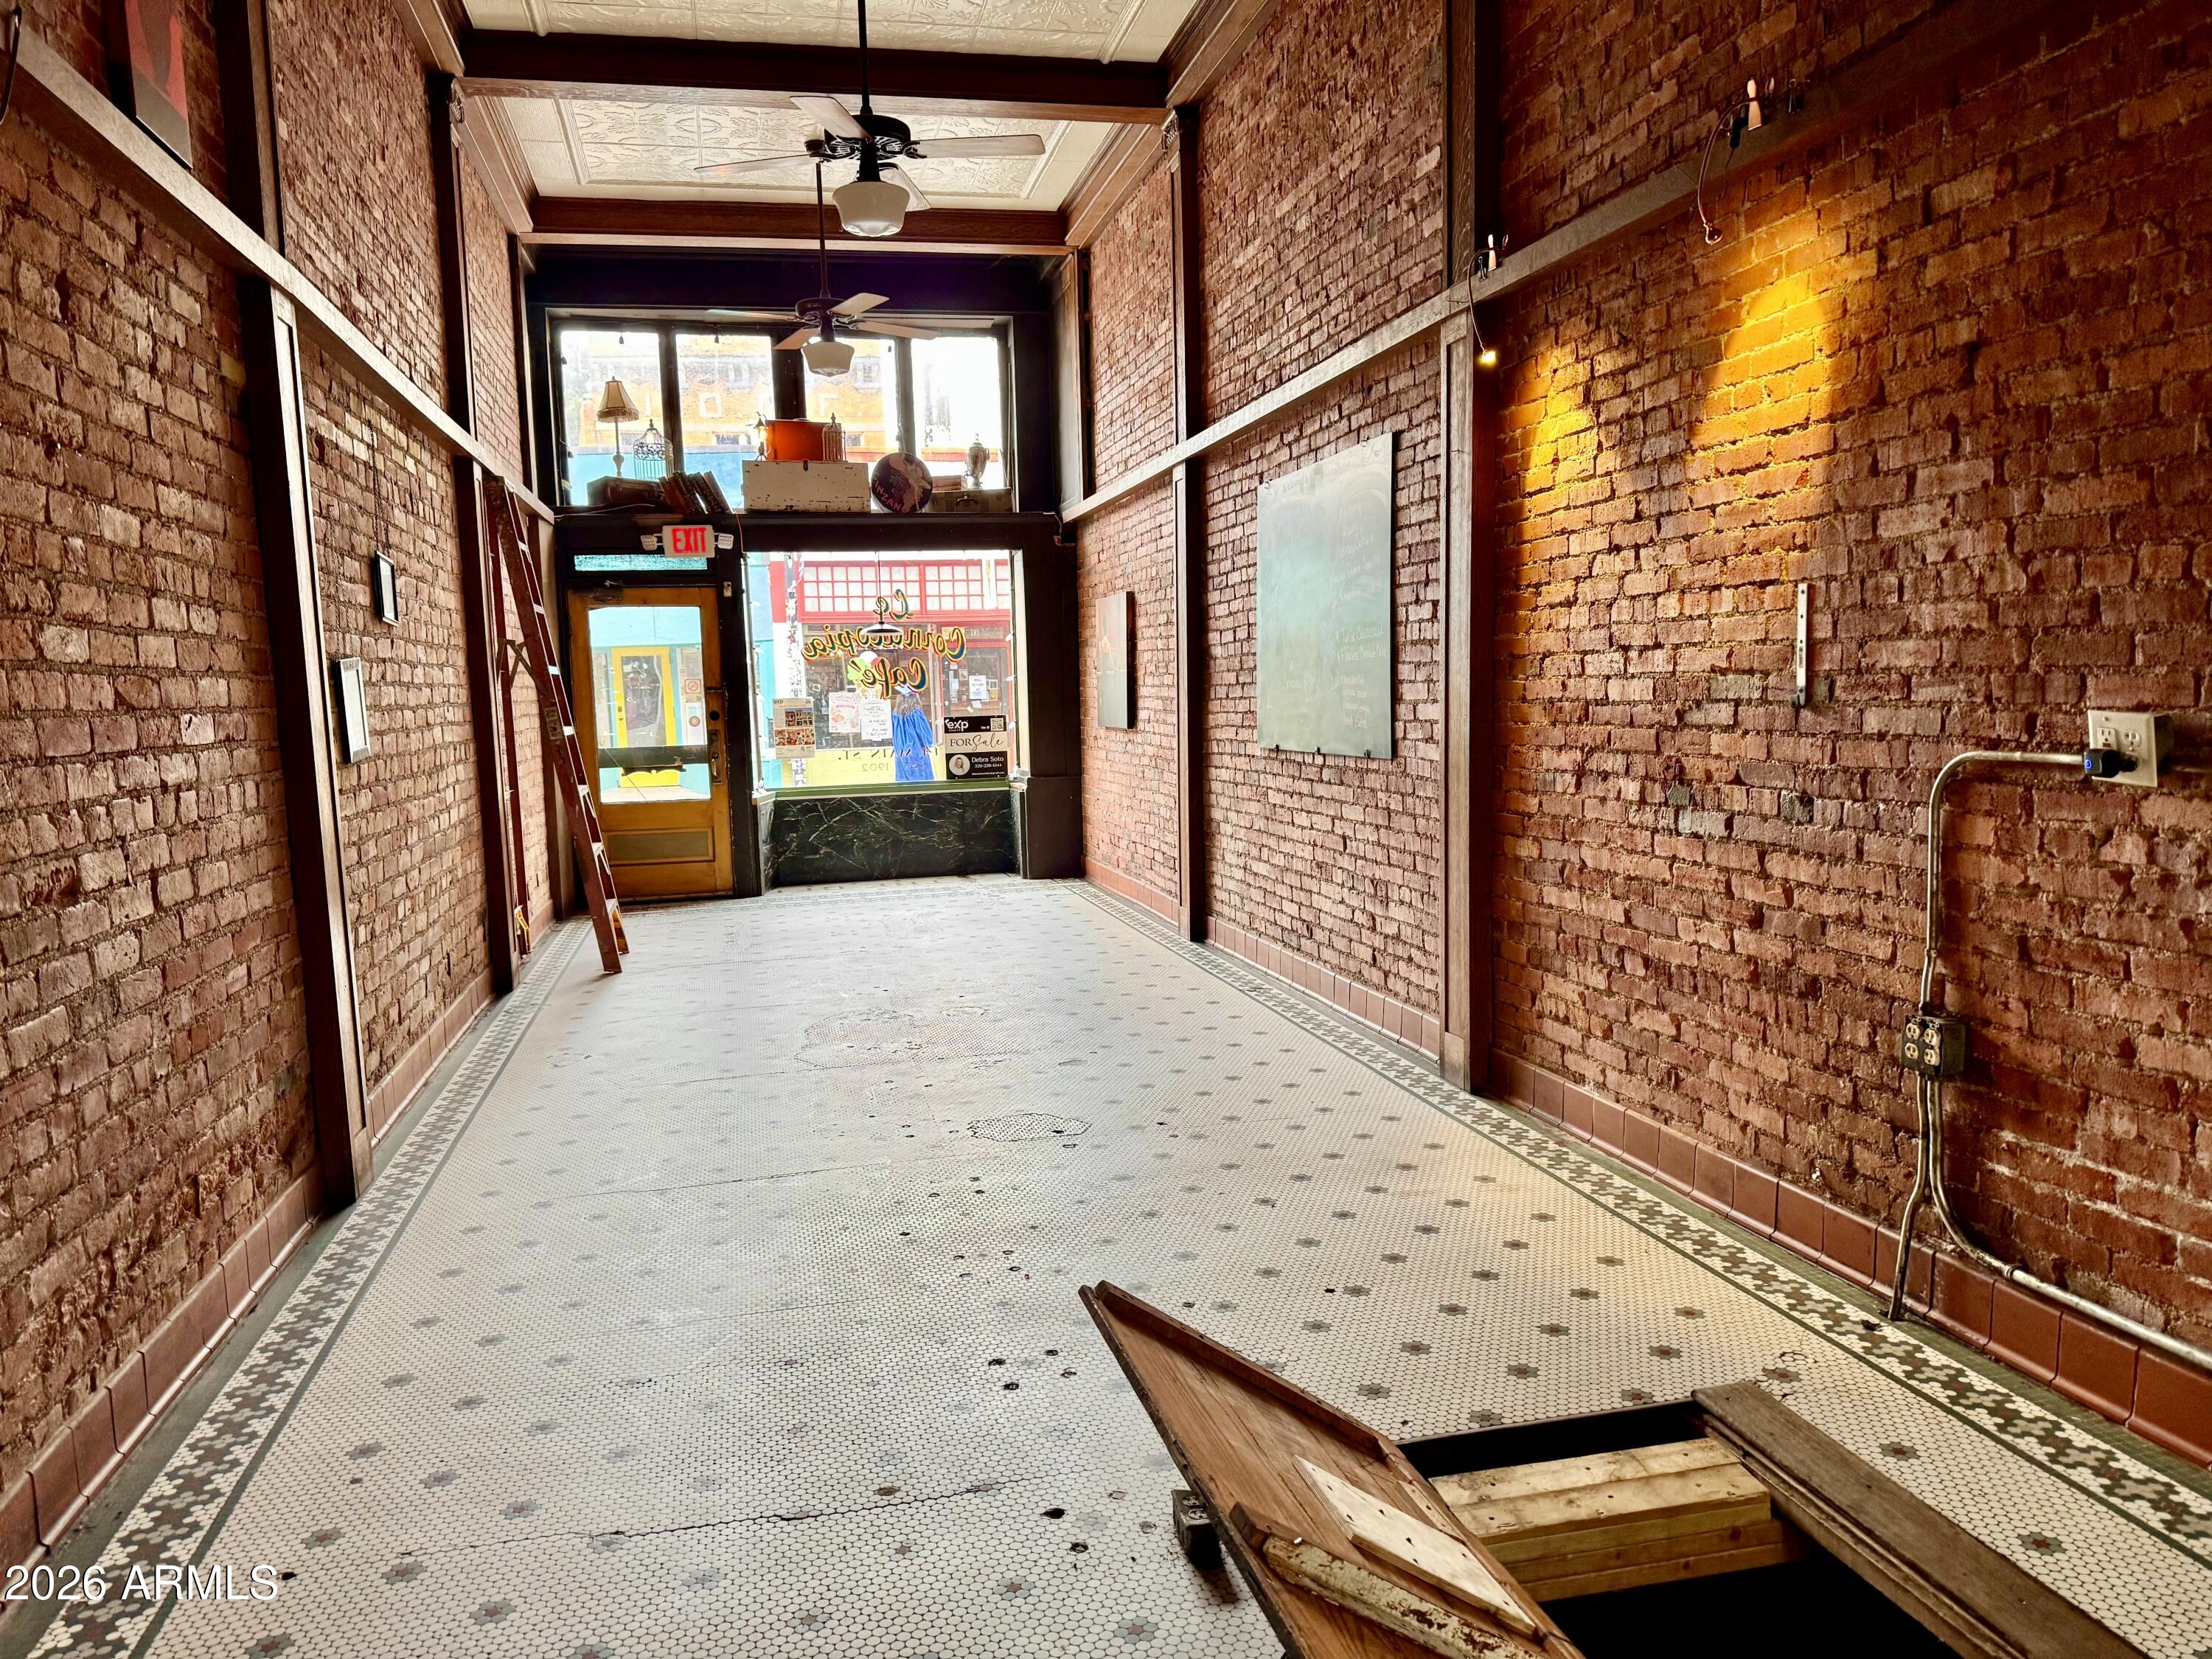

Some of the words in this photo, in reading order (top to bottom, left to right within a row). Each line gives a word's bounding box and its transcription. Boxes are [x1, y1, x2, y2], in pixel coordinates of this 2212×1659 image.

[672, 527, 706, 553] EXIT
[950, 738, 973, 747] FOR
[972, 732, 1004, 751] Sale
